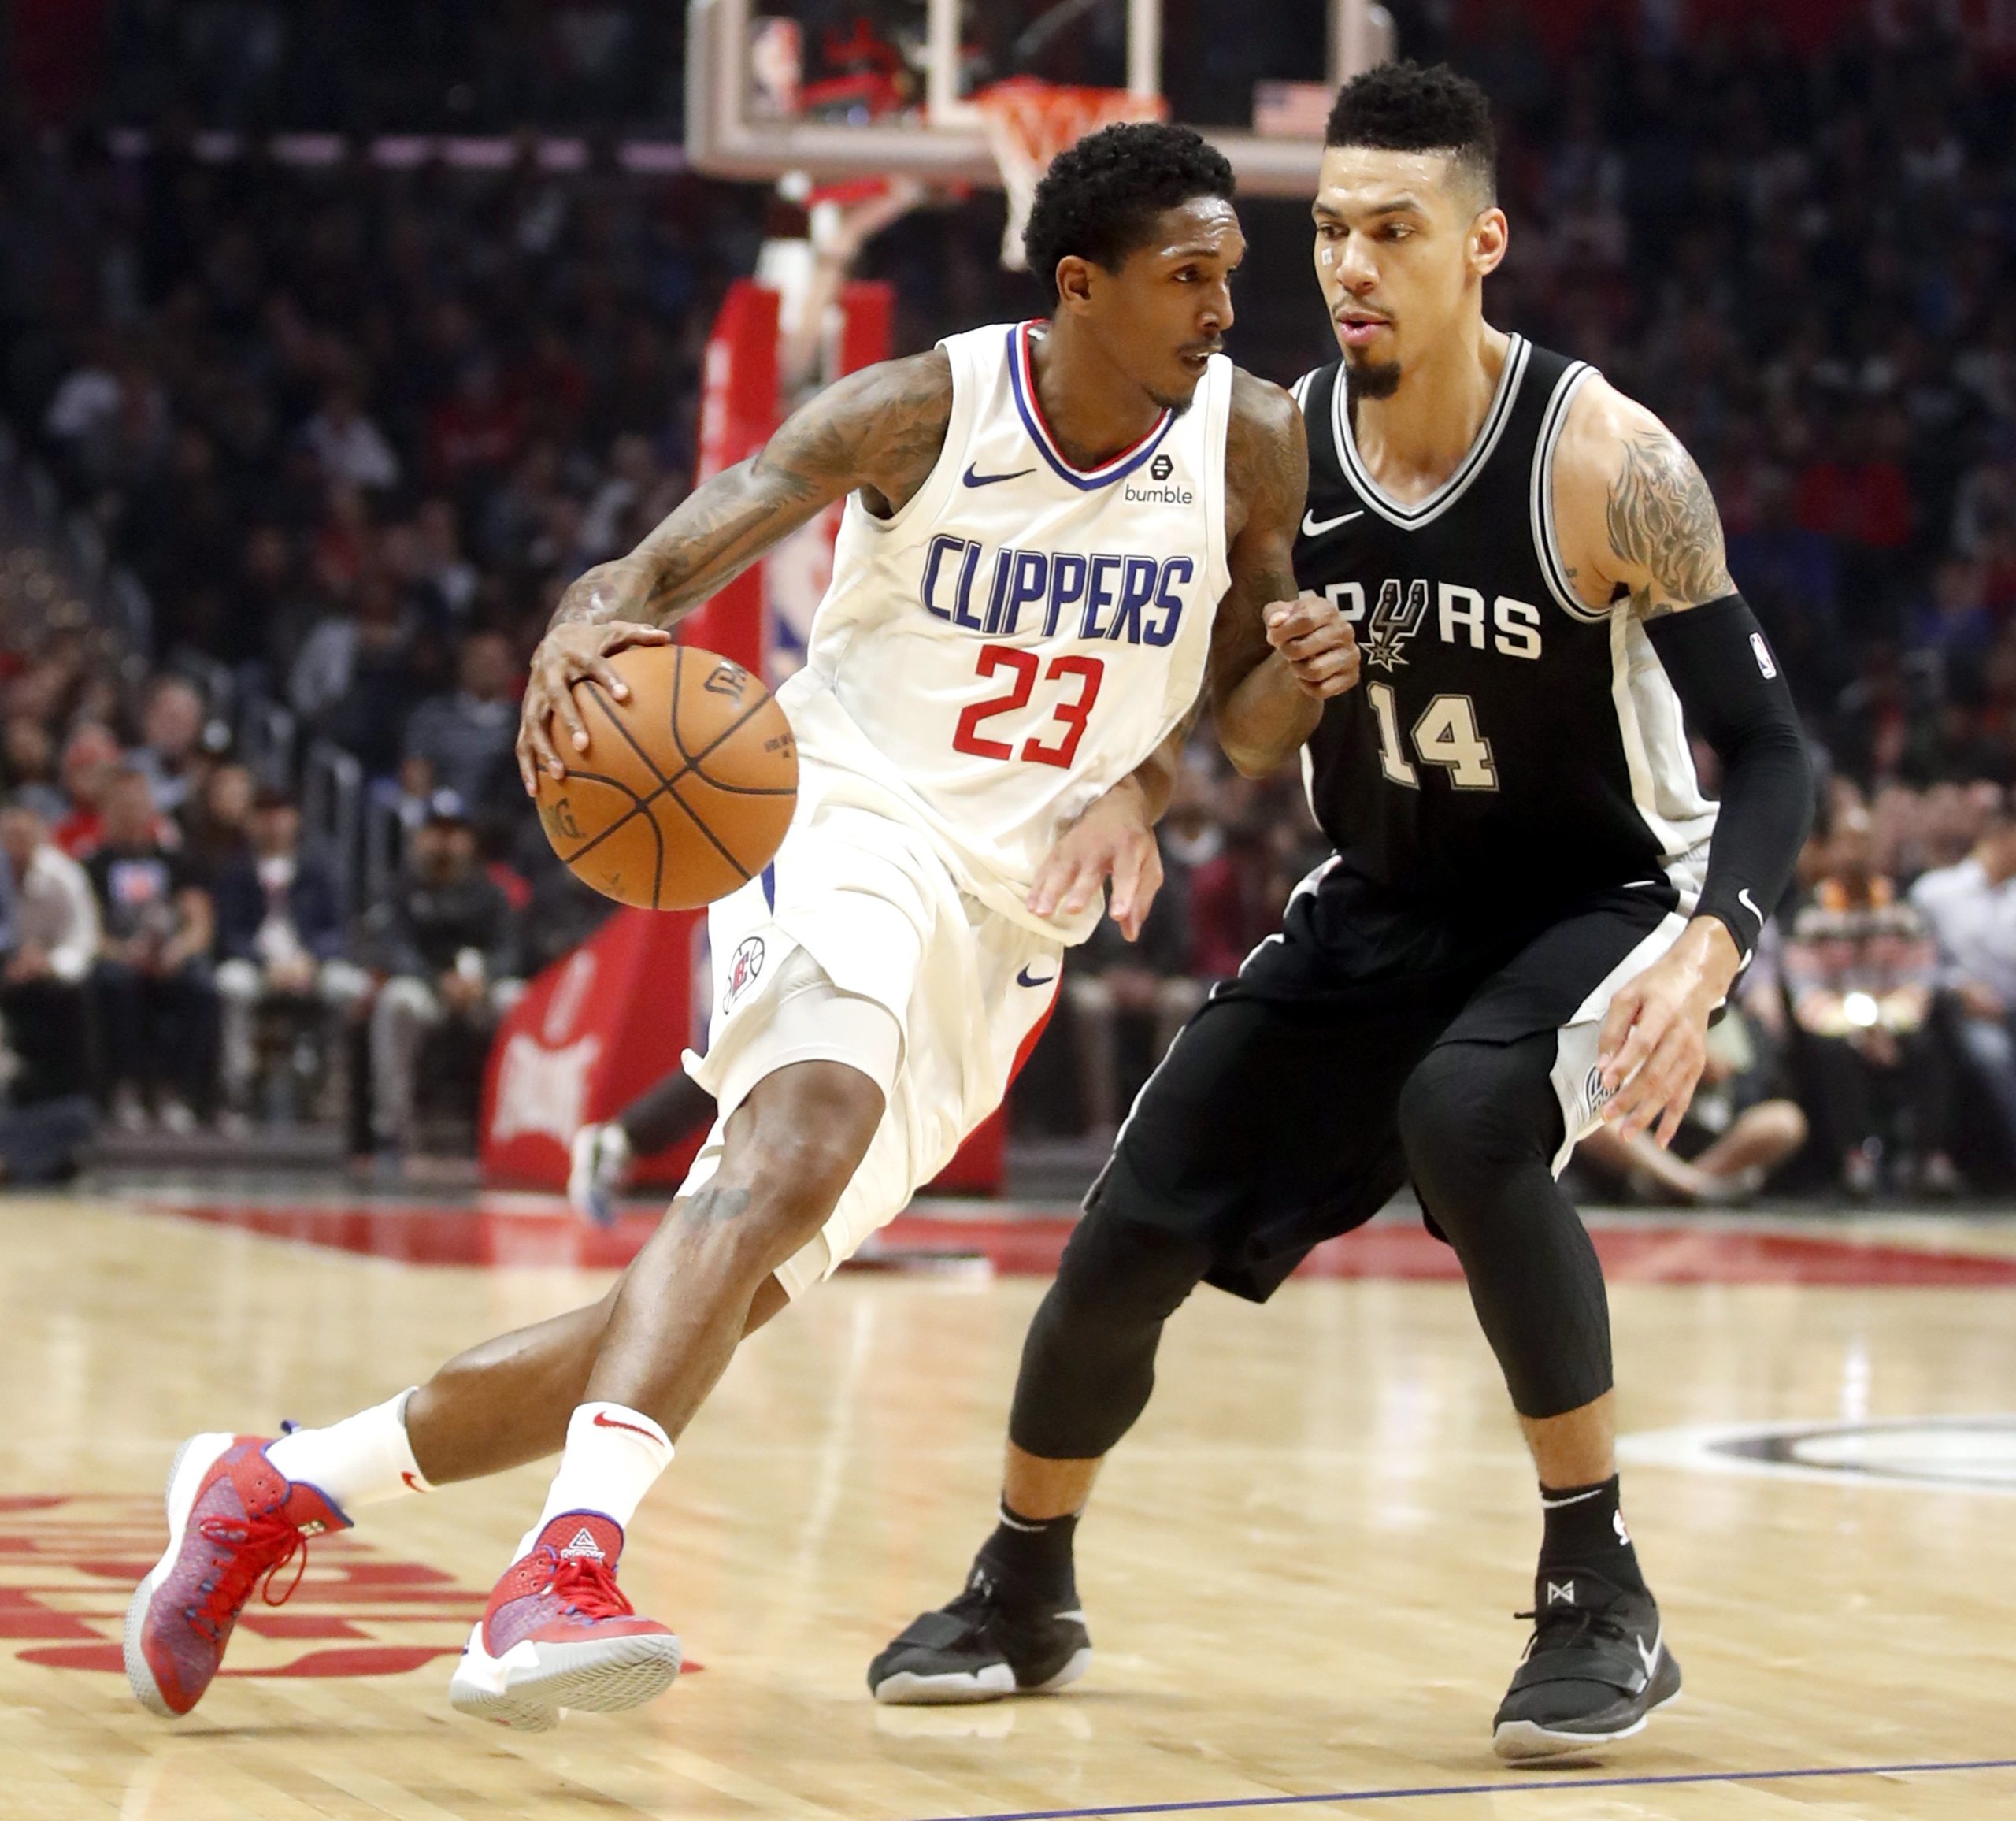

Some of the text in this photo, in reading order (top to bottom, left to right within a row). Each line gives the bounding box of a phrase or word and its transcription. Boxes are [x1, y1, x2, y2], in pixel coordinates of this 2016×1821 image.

[1125, 485, 1192, 504] bumble
[921, 533, 1194, 647] CLIPPERS
[953, 643, 1105, 770] 23
[1366, 680, 1499, 792] 14
